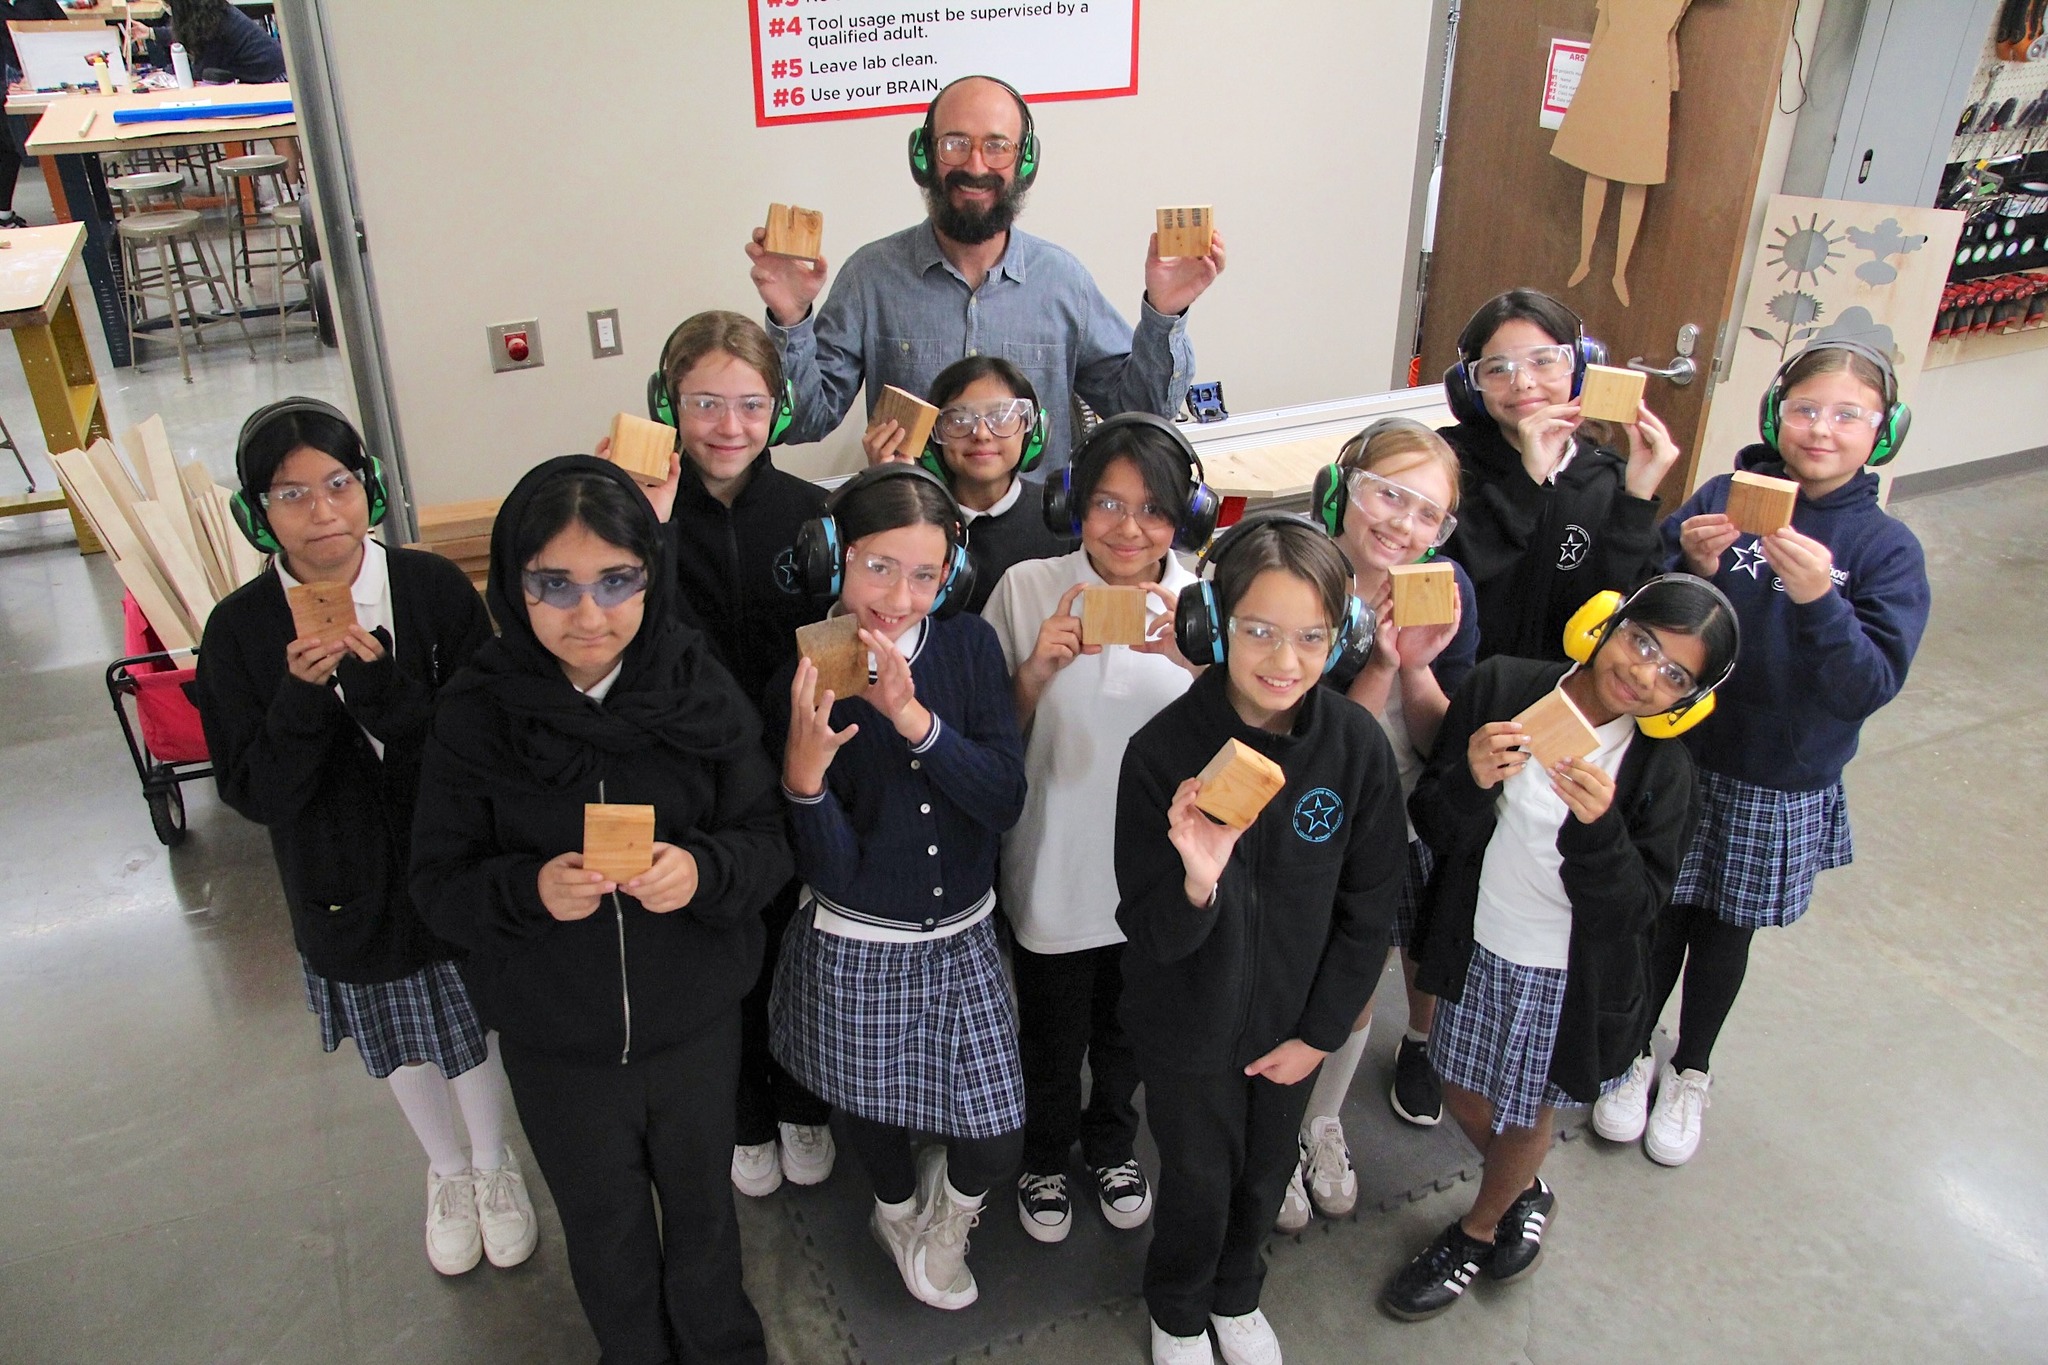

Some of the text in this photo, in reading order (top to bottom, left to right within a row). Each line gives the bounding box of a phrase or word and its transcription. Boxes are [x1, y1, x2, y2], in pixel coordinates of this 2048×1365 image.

[769, 1, 1089, 37] #4 Tool usage must be supervised by a
[808, 26, 928, 49] qualified adult.
[771, 53, 938, 79] #5 Leave lab clean.
[1569, 53, 1585, 61] ARS
[773, 78, 943, 107] #6 Use your BRAIN.
